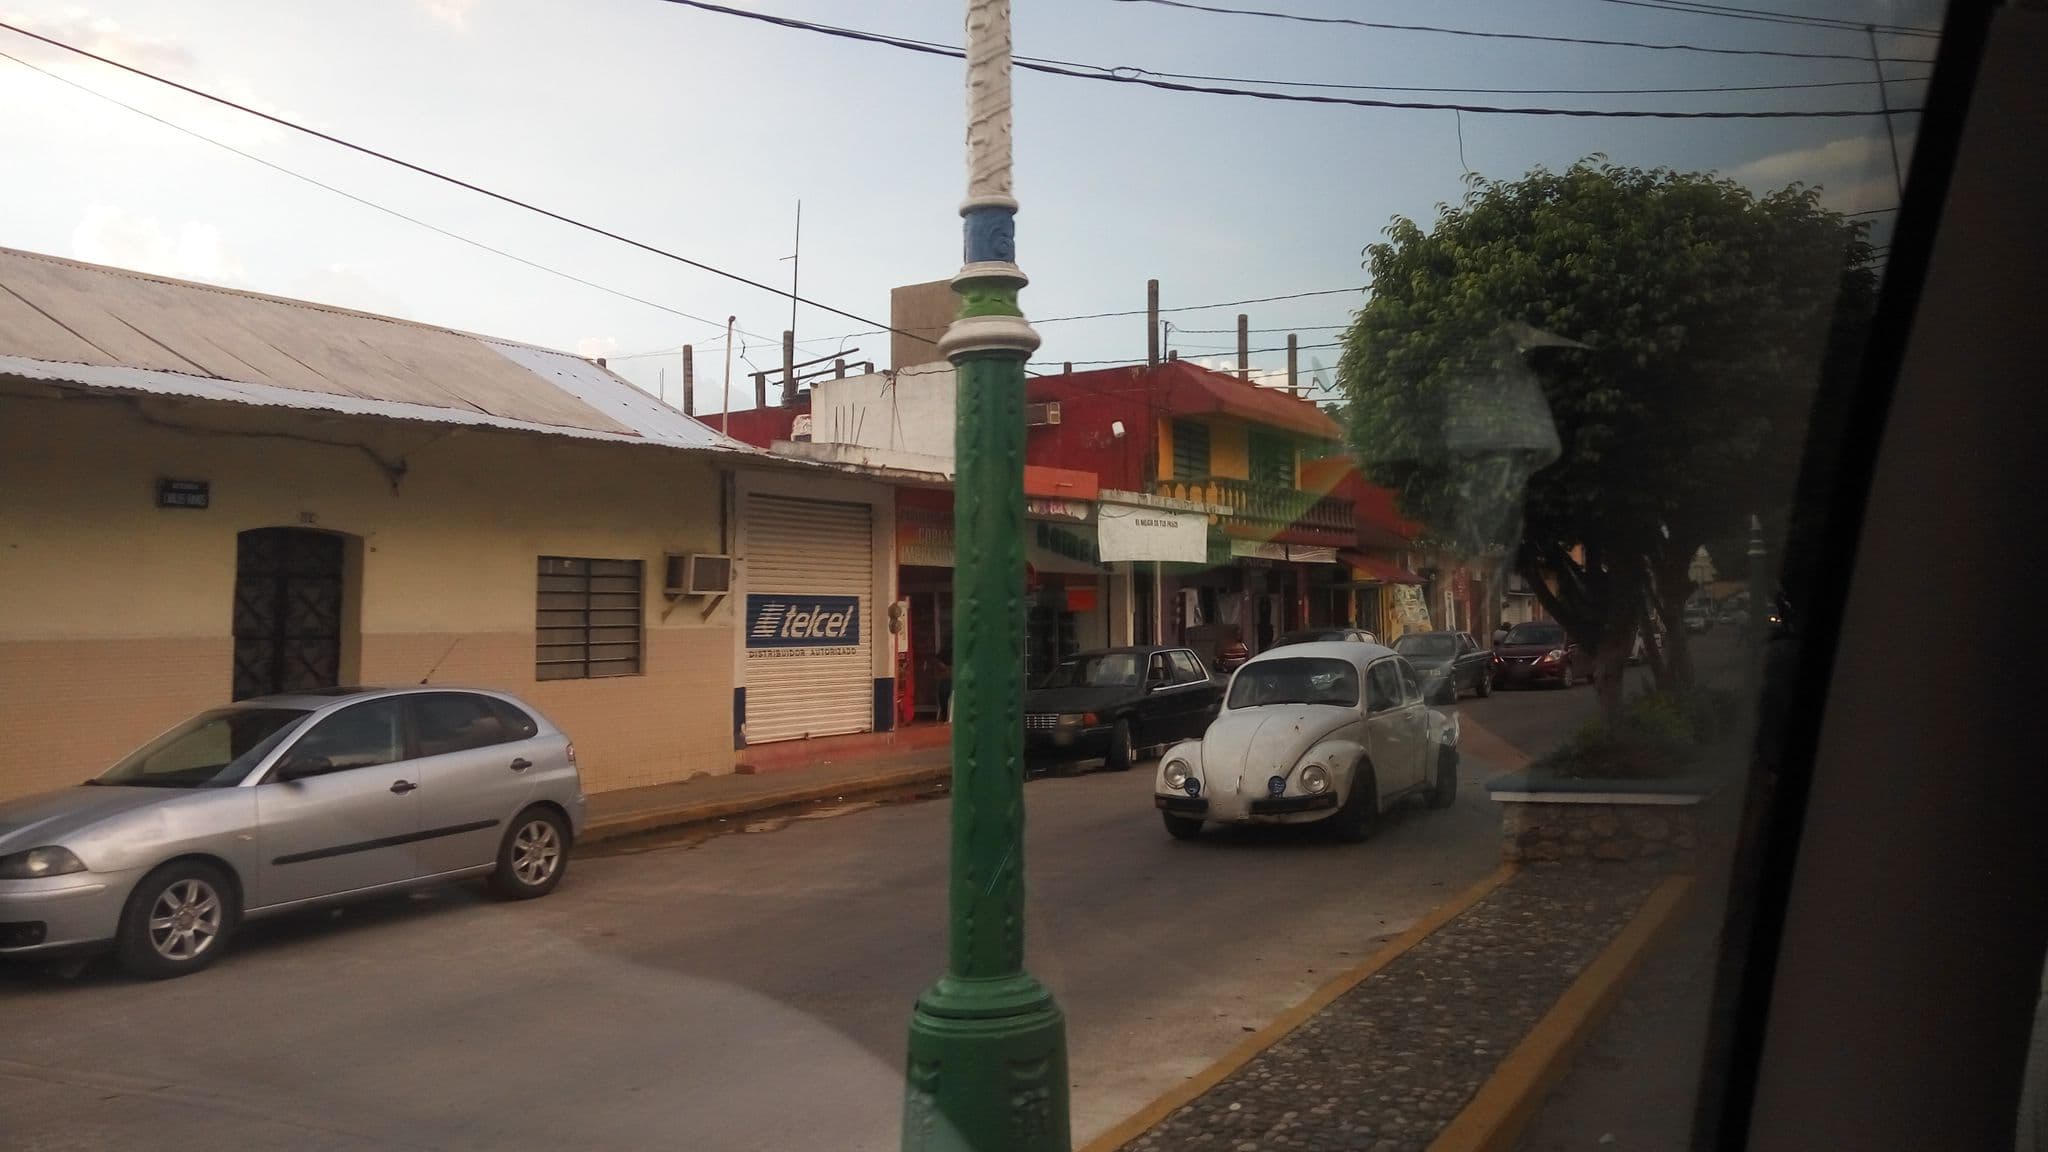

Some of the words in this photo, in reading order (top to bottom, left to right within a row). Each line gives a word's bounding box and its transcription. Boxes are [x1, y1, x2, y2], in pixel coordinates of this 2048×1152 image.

[781, 604, 854, 638] telcel
[749, 649, 806, 658] DISTRIBUIDOR
[810, 647, 857, 657] AUTORIZADO
